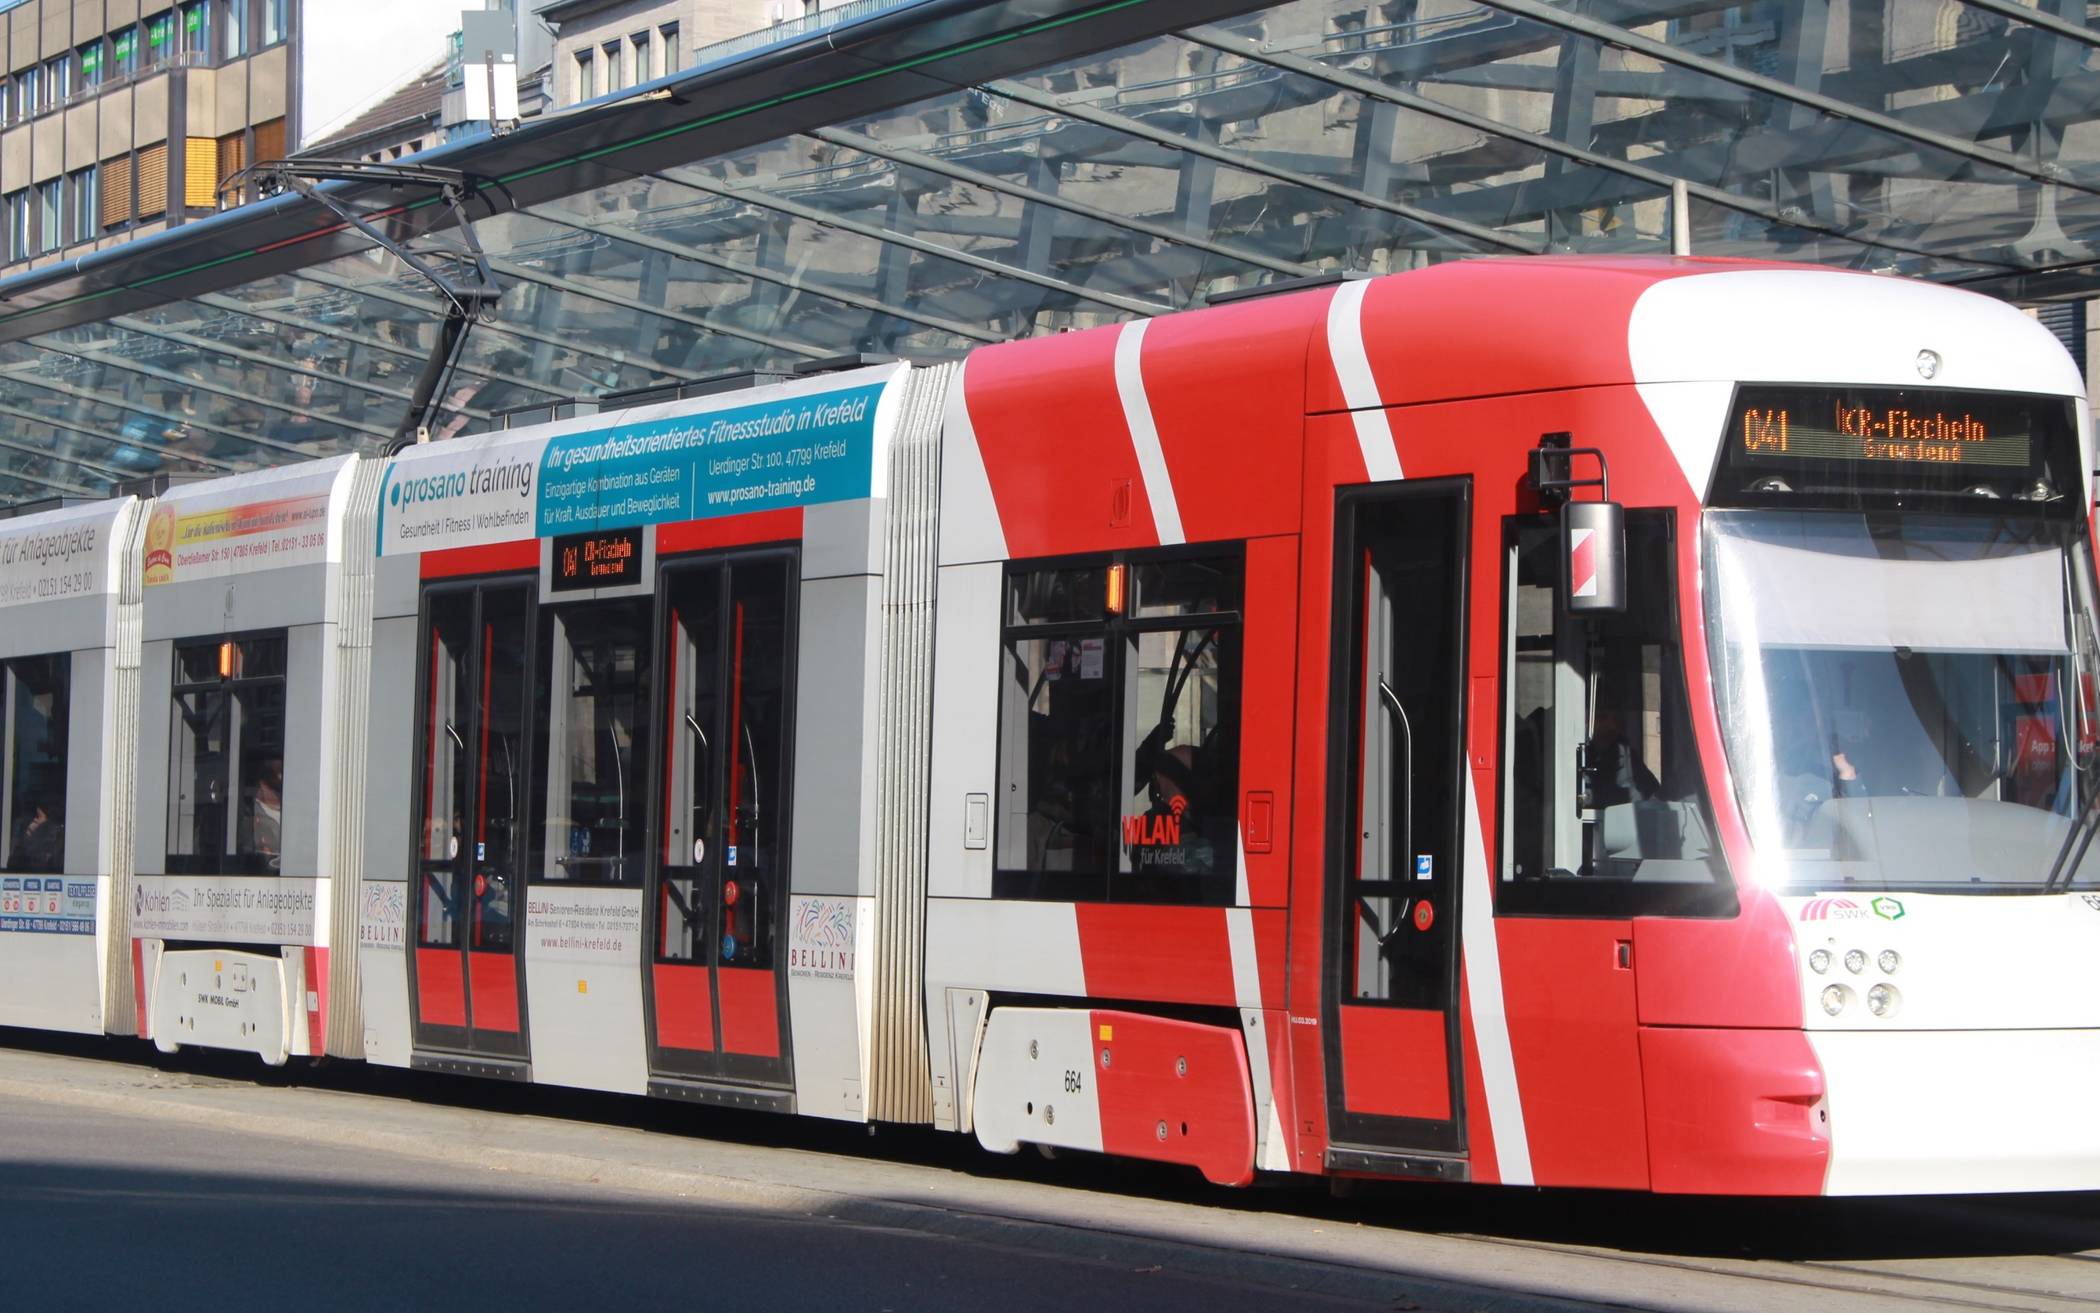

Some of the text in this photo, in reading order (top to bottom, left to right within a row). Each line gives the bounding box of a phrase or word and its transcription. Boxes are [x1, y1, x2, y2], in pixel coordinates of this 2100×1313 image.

[547, 395, 868, 472] Ihr gesundheitsorientiertes Fitnessstudio in Krefeld
[1744, 407, 1986, 451] 041 KR-Fischeln
[709, 456, 750, 476] Uerdinger
[785, 447, 812, 467] 47799
[814, 439, 847, 460] Krefeld
[402, 456, 533, 513] prosano training
[545, 467, 680, 500] Einzigartige Kombination aus Geräten
[708, 474, 815, 506] www.prosano-training.de
[544, 508, 554, 525] für
[575, 504, 610, 521] Ausdauer
[611, 499, 626, 516] und
[627, 493, 680, 516] Beweglichkeit
[400, 509, 529, 539] Gesundheit Fitness Wohlbefinden
[2, 526, 96, 565] für Anlageobjekte
[249, 541, 268, 556] Krefeld
[39, 577, 57, 597] 02151
[60, 575, 72, 594] 154
[74, 574, 82, 592] 29
[84, 571, 92, 590] 00
[1122, 815, 1180, 845] WLAN
[1141, 848, 1185, 865] für Krefeld
[144, 888, 313, 915] Kohlen Ihr Spezialist für Anlageobjekte
[528, 902, 549, 915] BELLINI
[600, 905, 621, 917] Krefeld
[622, 906, 639, 918] GmbH
[1834, 909, 1869, 920] SWK
[360, 925, 405, 943] BELLINI
[541, 935, 622, 951] www.bellini-krefeld.de
[791, 949, 855, 971] BELLINI
[1064, 1069, 1082, 1094] 664
